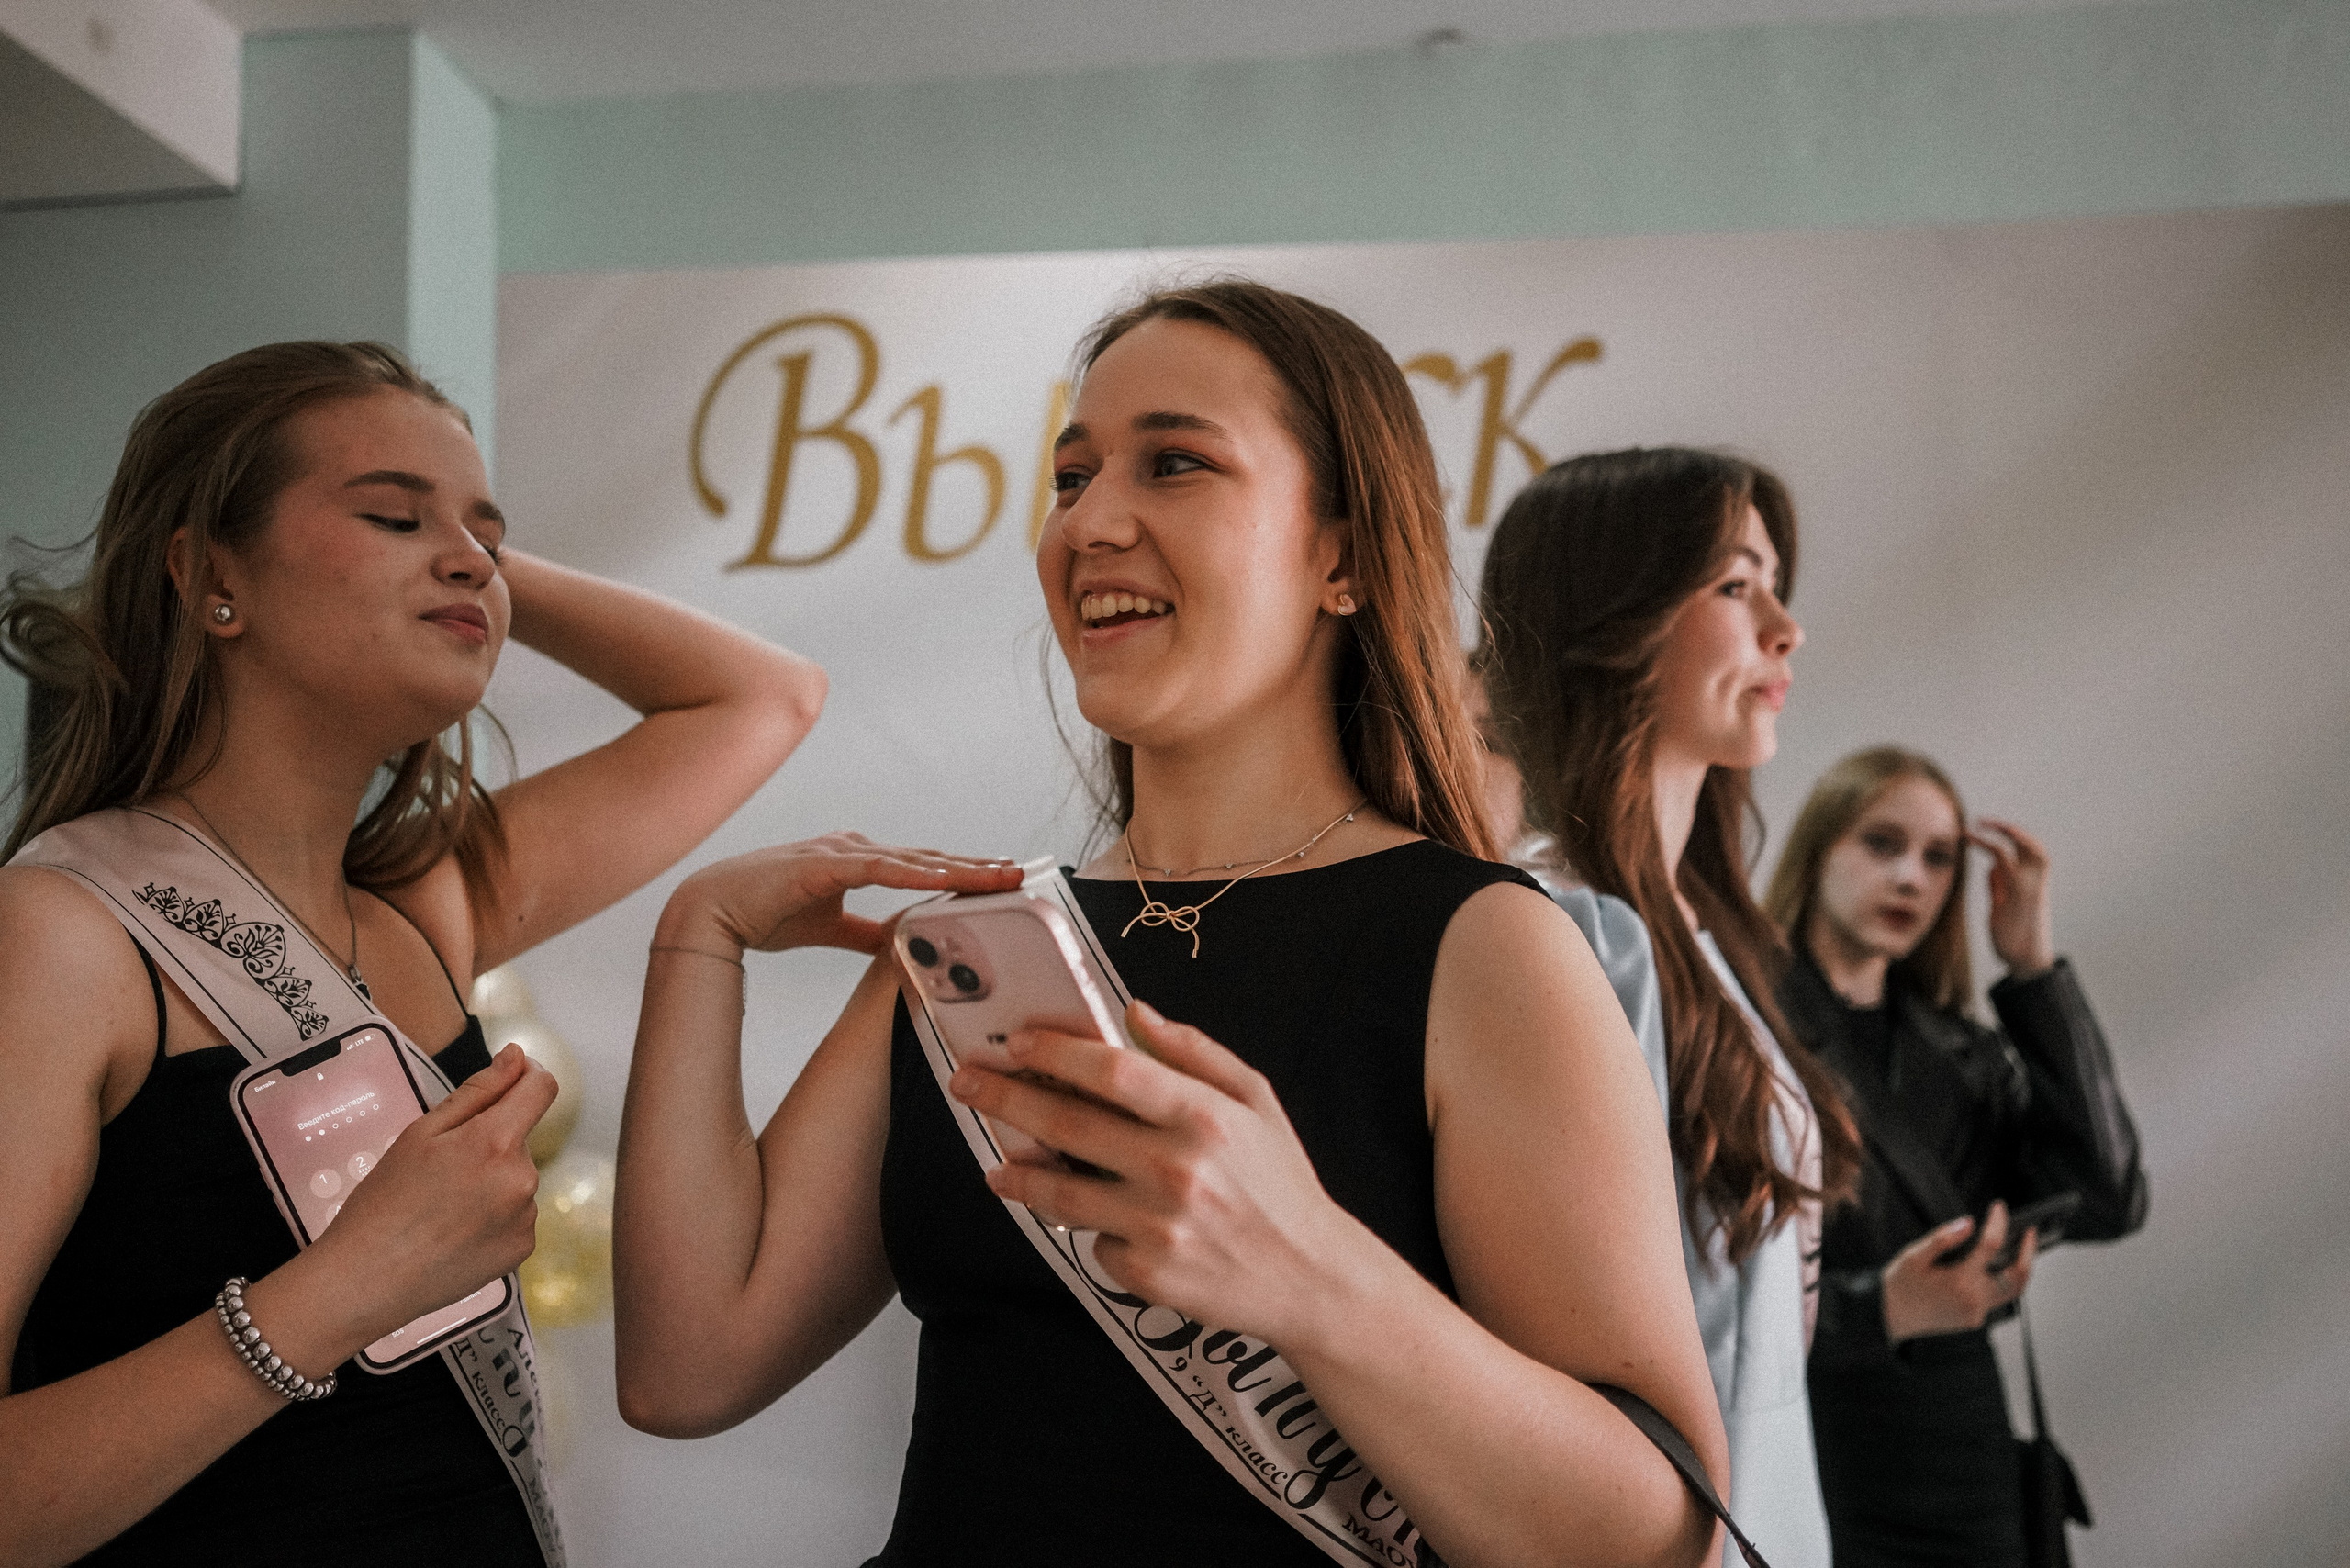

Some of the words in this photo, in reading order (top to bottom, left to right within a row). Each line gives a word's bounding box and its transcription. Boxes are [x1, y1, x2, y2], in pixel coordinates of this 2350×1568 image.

[688, 312, 1604, 573] Вык
[355, 1038, 364, 1047] LTE
[254, 1080, 276, 1092] Билайн
[297, 1111, 330, 1131] Введите
[331, 1091, 375, 1115] код-пароль
[319, 1173, 328, 1184] 1
[355, 1156, 366, 1168] 2
[391, 1327, 405, 1338] SOS
[471, 1371, 506, 1430] класс
[1169, 1356, 1188, 1372] 9
[1225, 1427, 1289, 1485] класс
